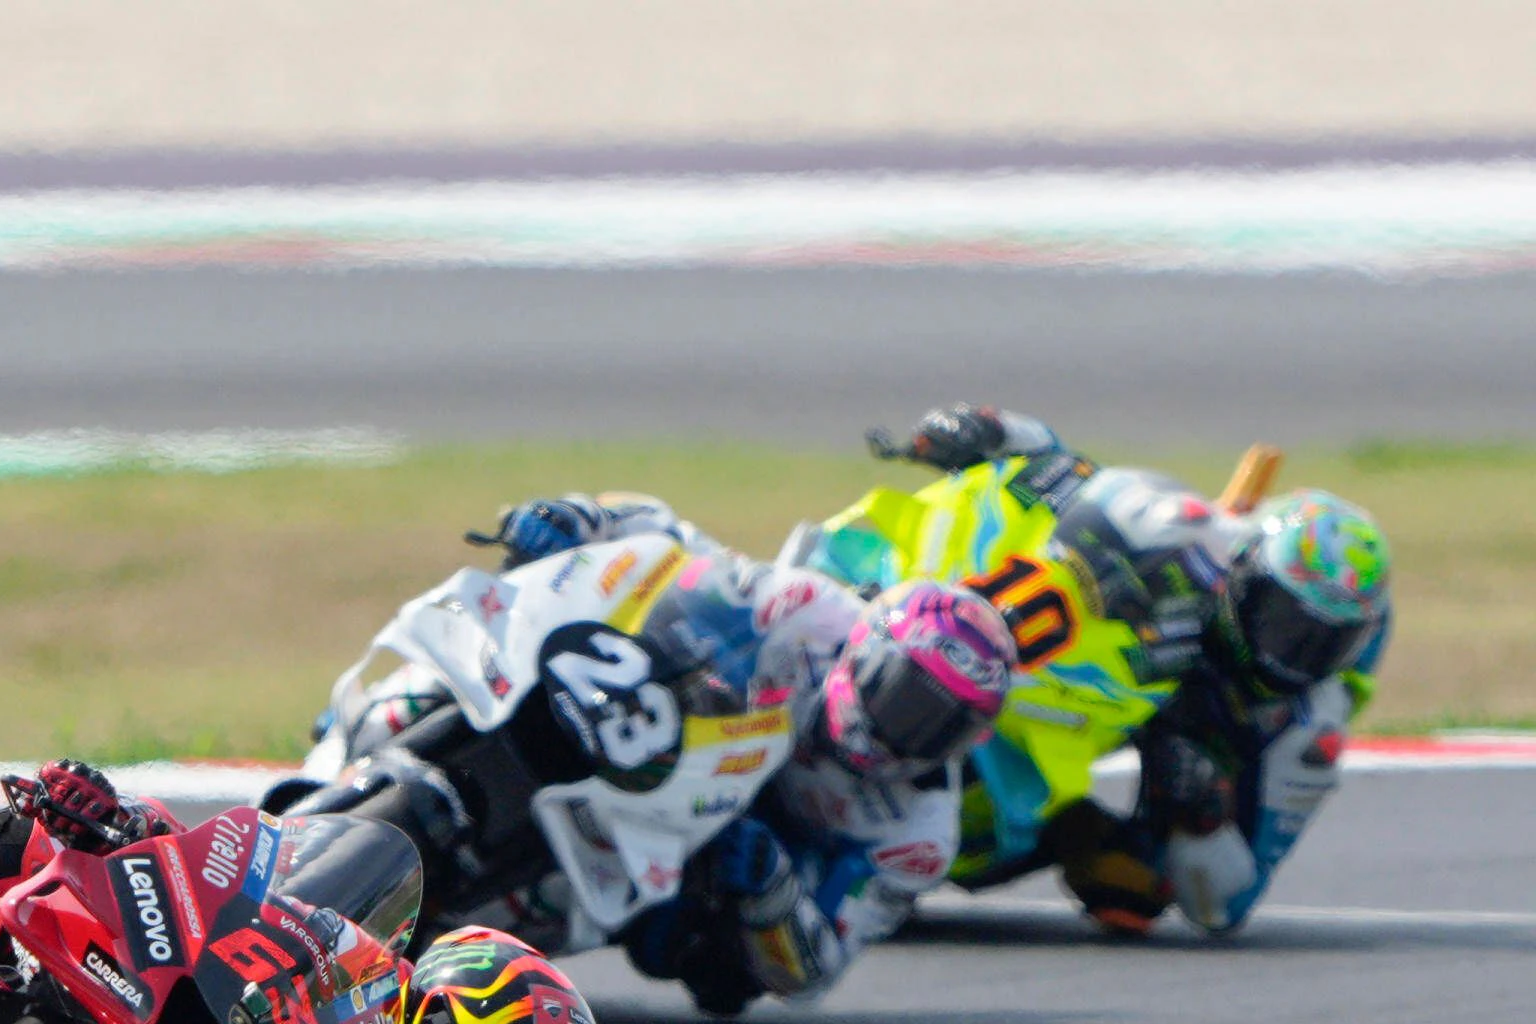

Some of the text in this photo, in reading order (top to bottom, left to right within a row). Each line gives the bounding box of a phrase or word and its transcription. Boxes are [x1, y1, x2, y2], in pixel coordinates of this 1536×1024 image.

[962, 553, 1078, 673] 10
[546, 631, 681, 769] 23
[122, 858, 173, 962] Lenovo
[86, 952, 144, 1008] CARRERA
